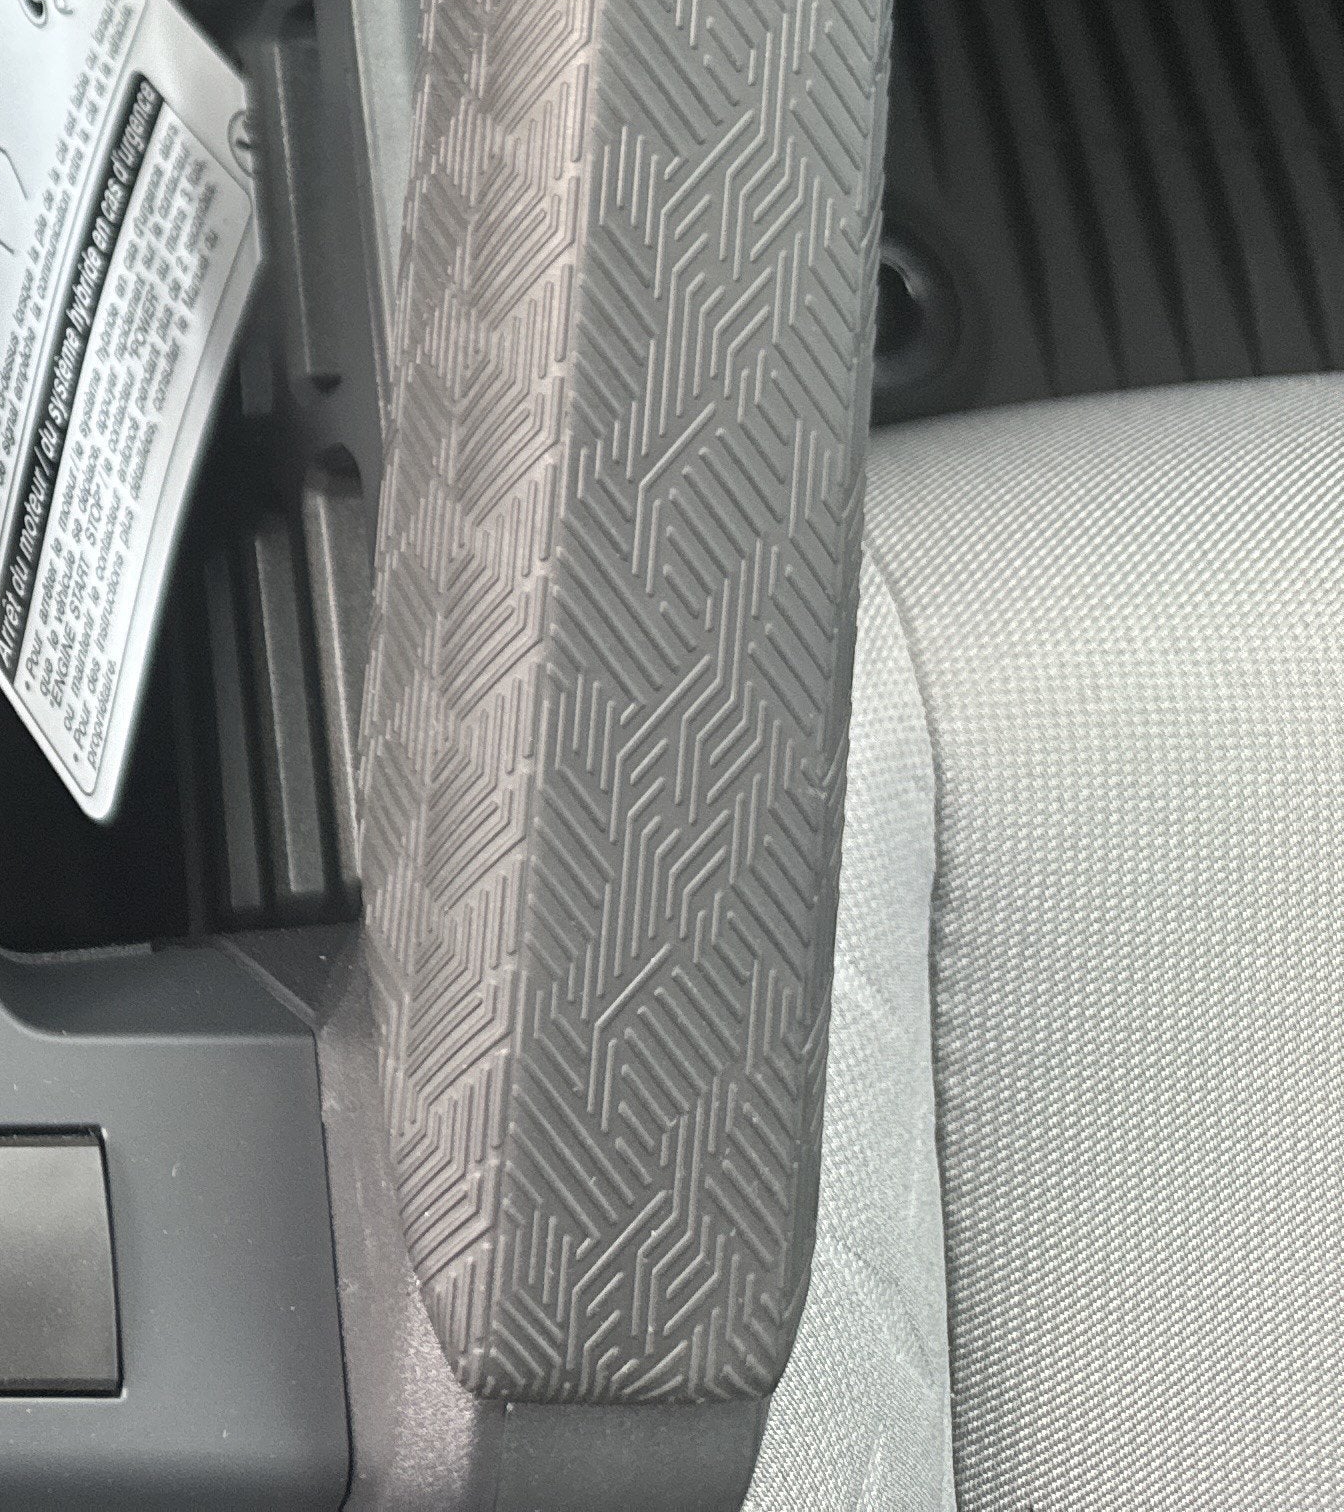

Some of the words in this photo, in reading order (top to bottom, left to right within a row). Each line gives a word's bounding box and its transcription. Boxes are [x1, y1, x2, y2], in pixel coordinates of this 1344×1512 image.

[111, 68, 156, 182] d'urgence
[91, 217, 111, 251] en
[100, 178, 123, 222] cas
[1, 399, 18, 456] signal
[13, 326, 36, 401] empêche
[29, 296, 42, 321] la
[36, 190, 70, 299] communication
[12, 267, 34, 327] lorsque
[27, 245, 40, 265] la
[66, 246, 102, 331] hybride
[48, 327, 80, 424] système
[25, 629, 43, 680] Pour
[38, 560, 57, 626] arrêter
[49, 536, 63, 558] le
[57, 467, 77, 532] moteur
[71, 440, 84, 461] le
[78, 367, 101, 438] système
[95, 302, 121, 363] hybride
[38, 420, 59, 459] du
[19, 467, 47, 560] moteur
[68, 551, 89, 620] START
[101, 457, 113, 477] le
[108, 366, 135, 453] contacteur
[9, 556, 29, 597] du
[39, 656, 53, 697] que
[46, 628, 59, 652] le
[54, 549, 75, 624] véhicule
[71, 517, 86, 544] se
[63, 702, 75, 732] ou
[70, 609, 94, 698] maintenir
[87, 585, 100, 607] le
[95, 488, 121, 581] contacteur
[117, 413, 140, 484] enfoncé
[72, 700, 91, 751] Pour
[86, 657, 101, 695] des
[94, 551, 124, 653] instructions
[119, 506, 135, 549] plus
[86, 660, 116, 771] propriétaire.
